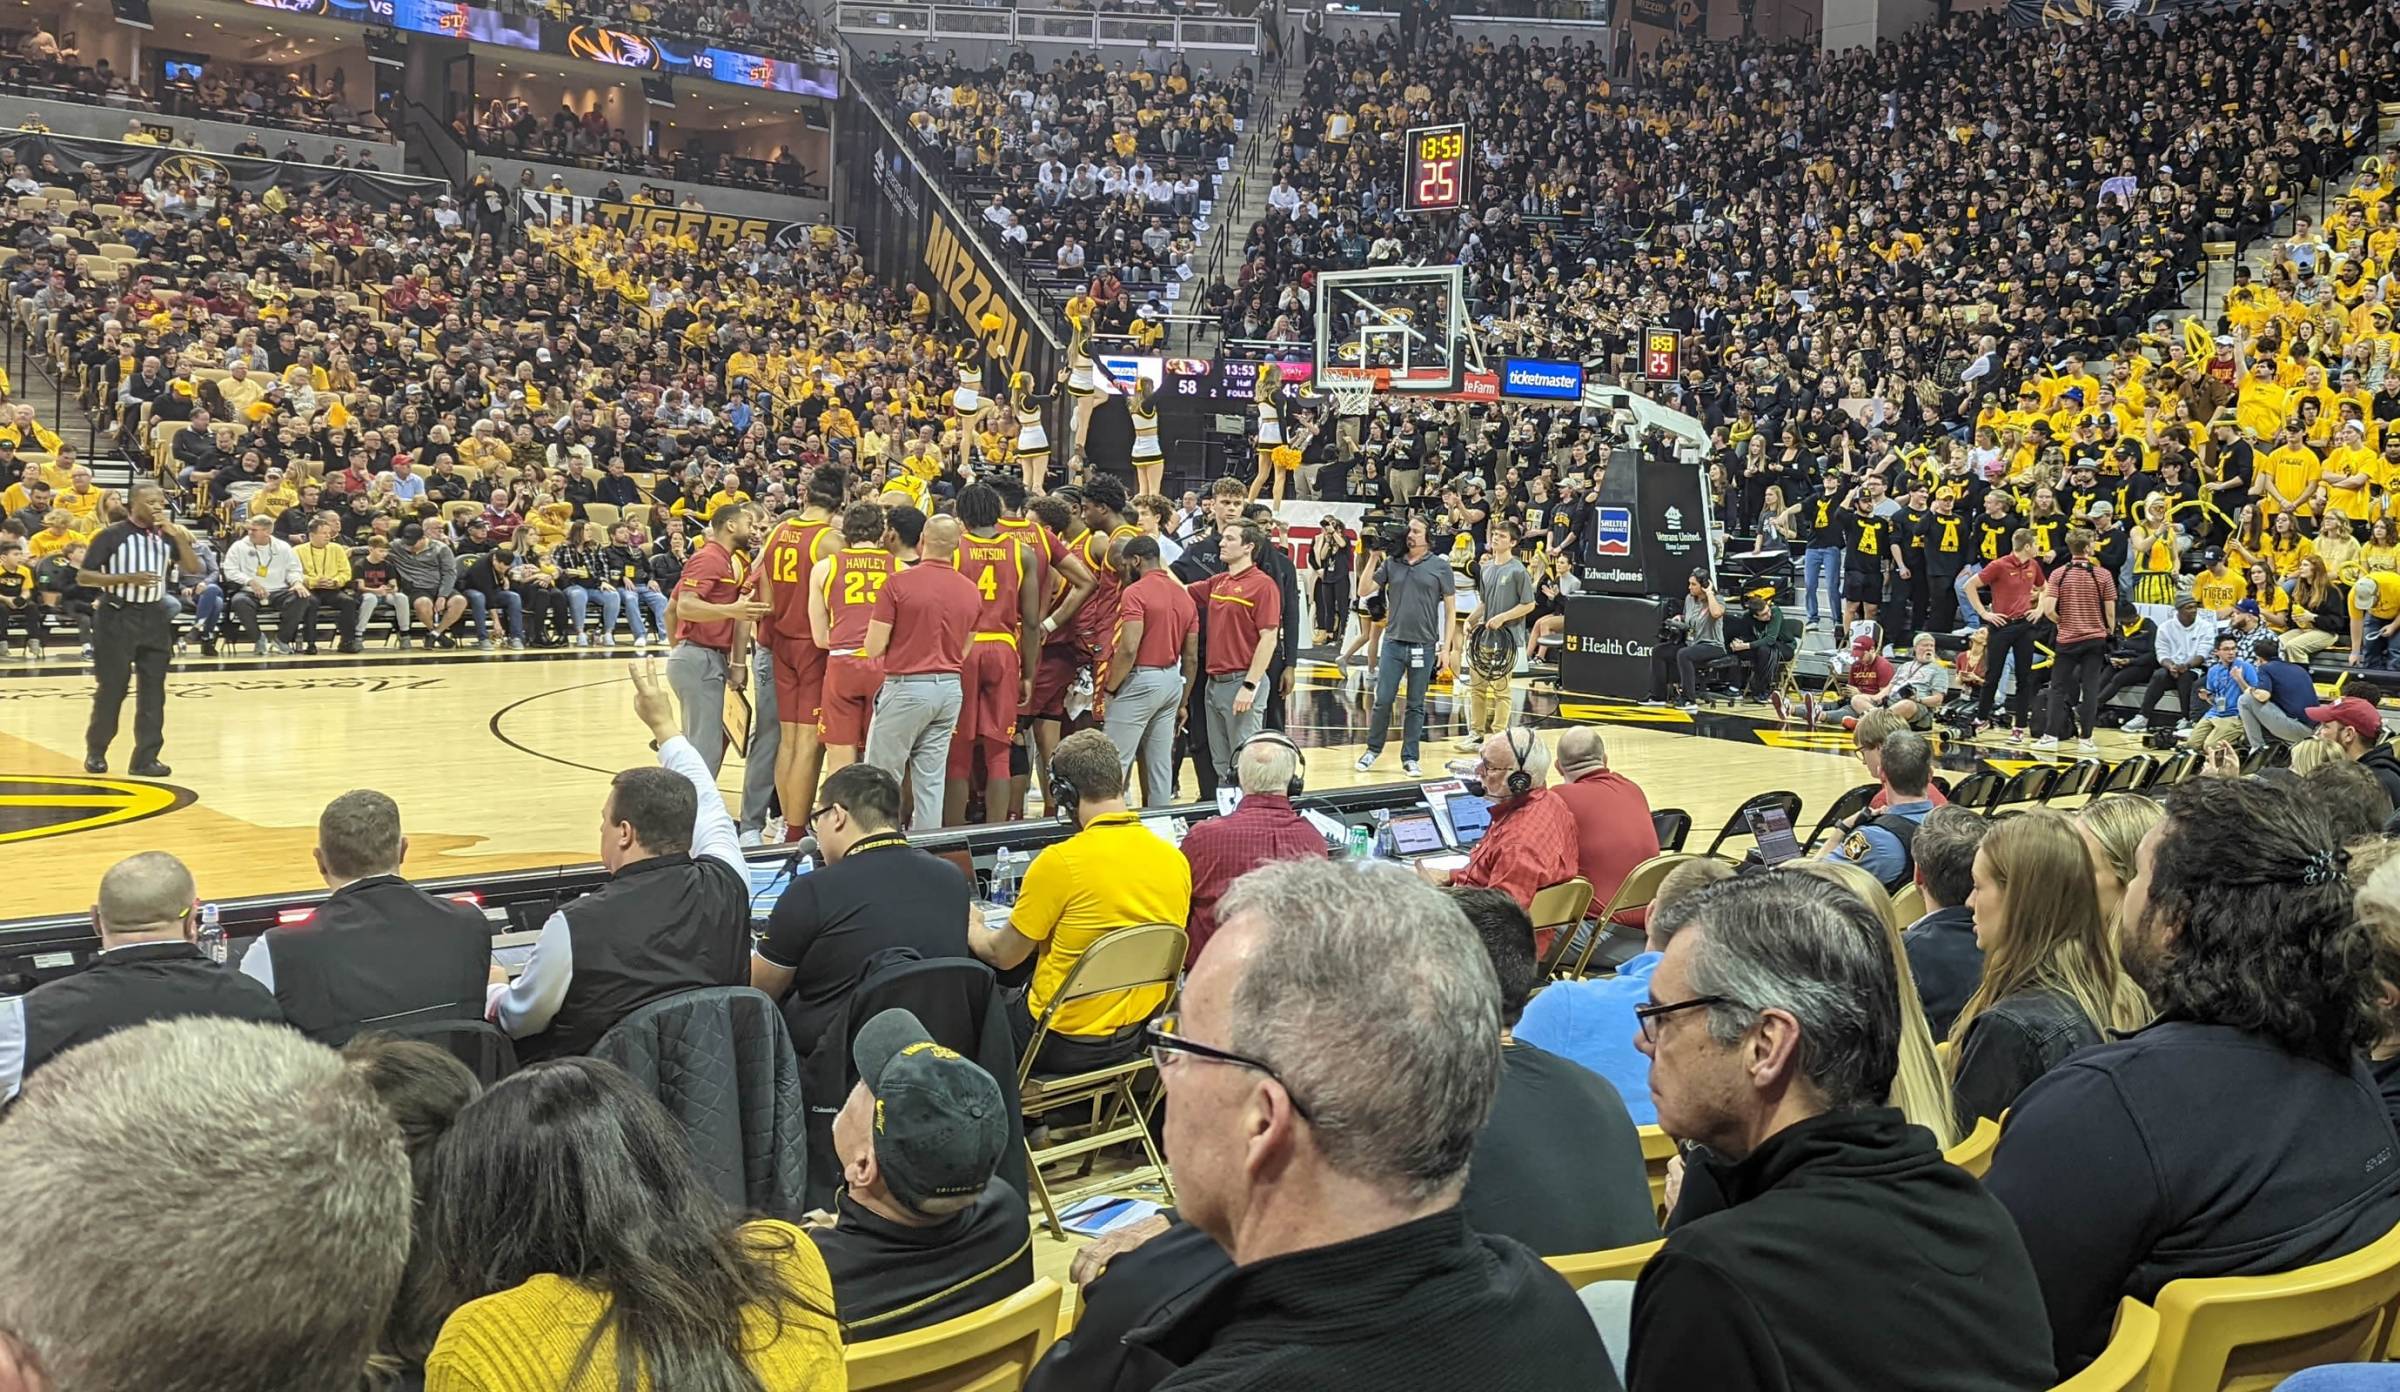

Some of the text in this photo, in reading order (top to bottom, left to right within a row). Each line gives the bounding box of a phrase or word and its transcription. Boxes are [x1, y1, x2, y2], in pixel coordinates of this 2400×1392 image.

[368, 1, 394, 15] VS
[692, 54, 713, 69] VS
[1421, 134, 1461, 160] 13:53
[1420, 161, 1453, 201] 25
[600, 202, 769, 248] TIGERS
[924, 209, 1030, 374] MIZZOU
[1224, 363, 1256, 377] 13:53
[1650, 353, 1668, 374] 25
[1178, 380, 1198, 394] 58
[1509, 369, 1577, 389] ticketmaster
[1210, 389, 1253, 397] 2 FOULS
[1600, 519, 1628, 528] SHELTER
[846, 557, 886, 570] HAWLEY
[969, 547, 1007, 560] WATSON
[772, 546, 798, 582] 12
[844, 571, 889, 604] 23
[977, 564, 997, 600] 4
[2203, 586, 2234, 600] TIGERS
[1582, 635, 1623, 655] Health
